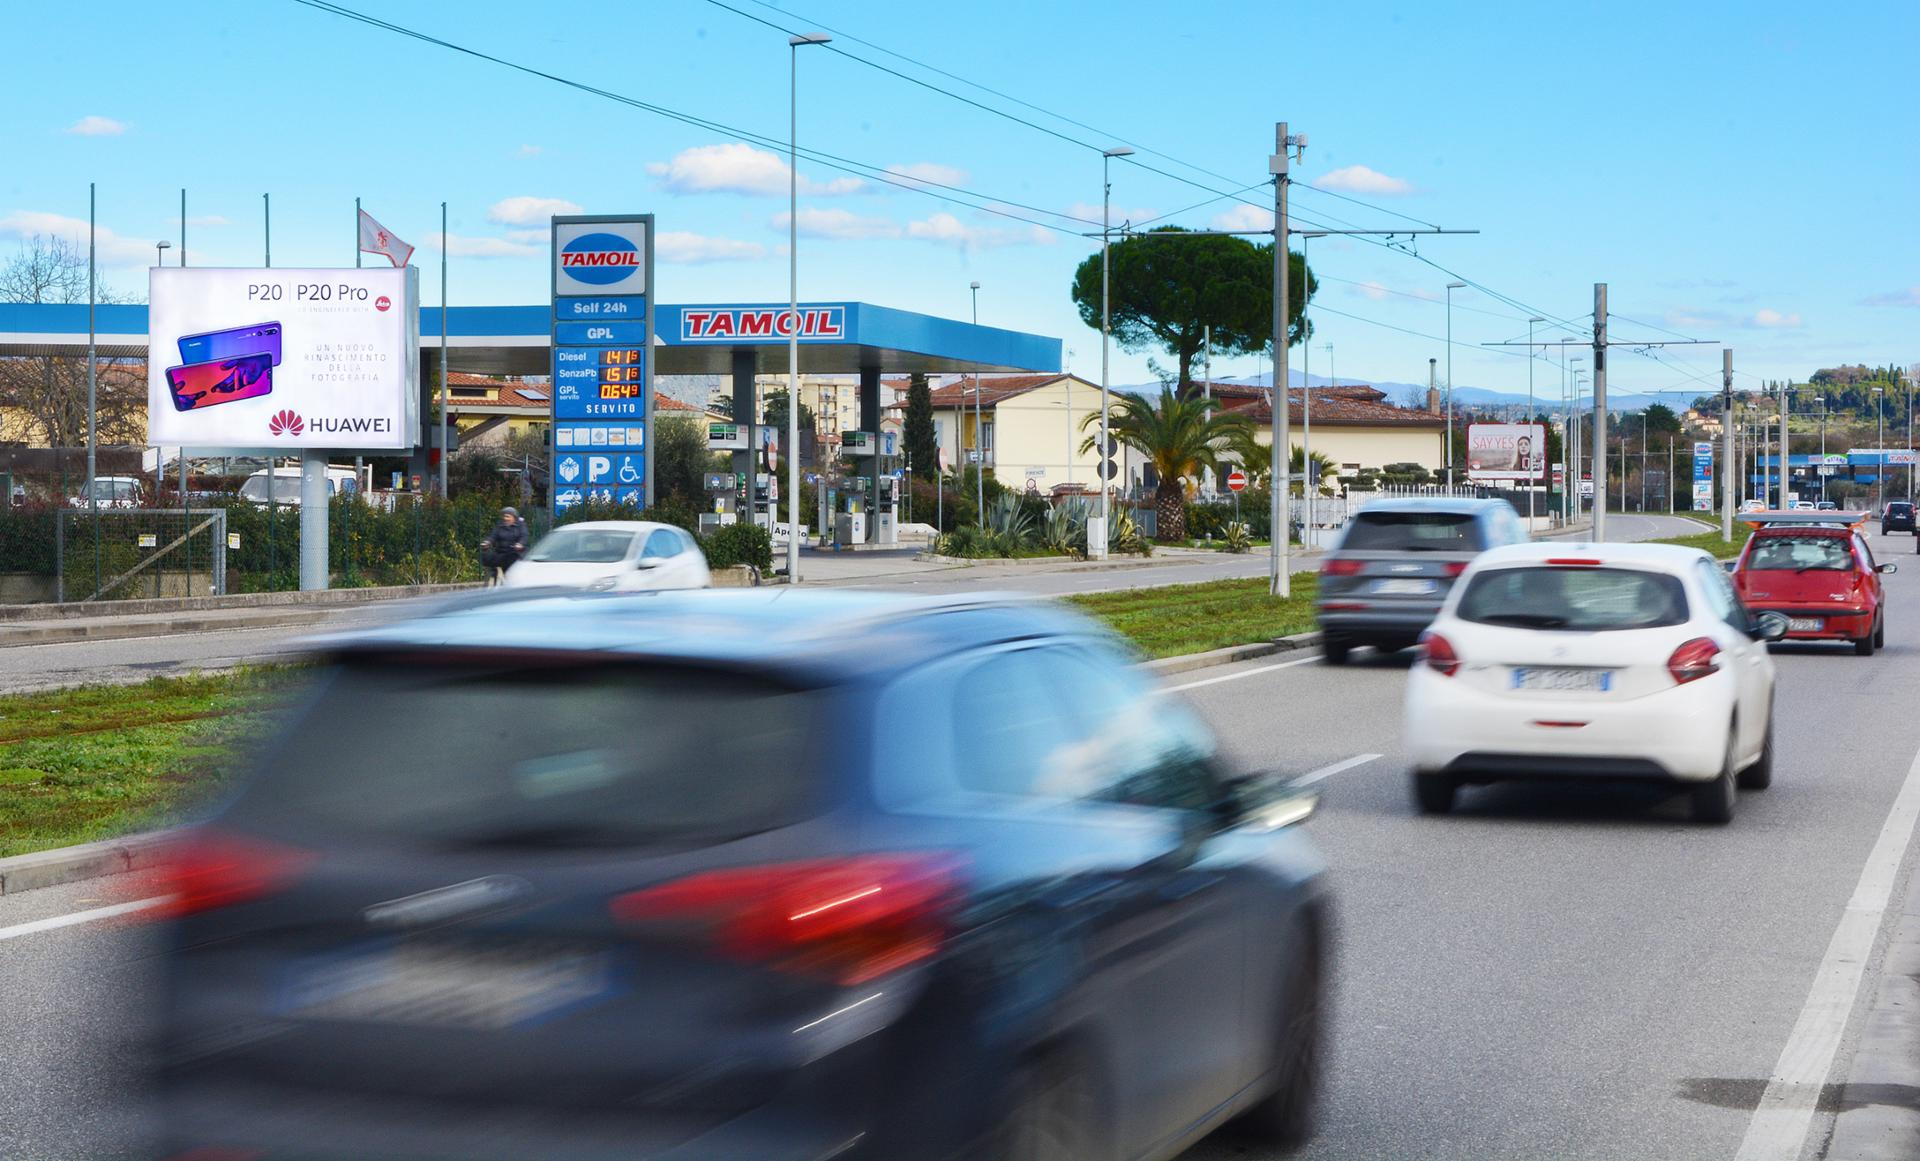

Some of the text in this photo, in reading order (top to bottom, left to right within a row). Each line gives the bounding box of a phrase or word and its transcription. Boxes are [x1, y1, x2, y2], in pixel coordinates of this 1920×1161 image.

[561, 252, 641, 266] TAMOIL
[248, 284, 368, 301] P20 P20 Pro
[574, 302, 627, 313] Self 24h
[686, 311, 840, 337] TAMOIL
[587, 328, 614, 339] GPL
[316, 344, 374, 352] UN NUOVO
[559, 352, 587, 361] Diesel
[559, 368, 597, 378] SenzaPb
[559, 385, 578, 395] GPL
[586, 403, 636, 414] SERVITO
[310, 417, 391, 433] HUAWEI
[1472, 436, 1515, 450] SAY YES
